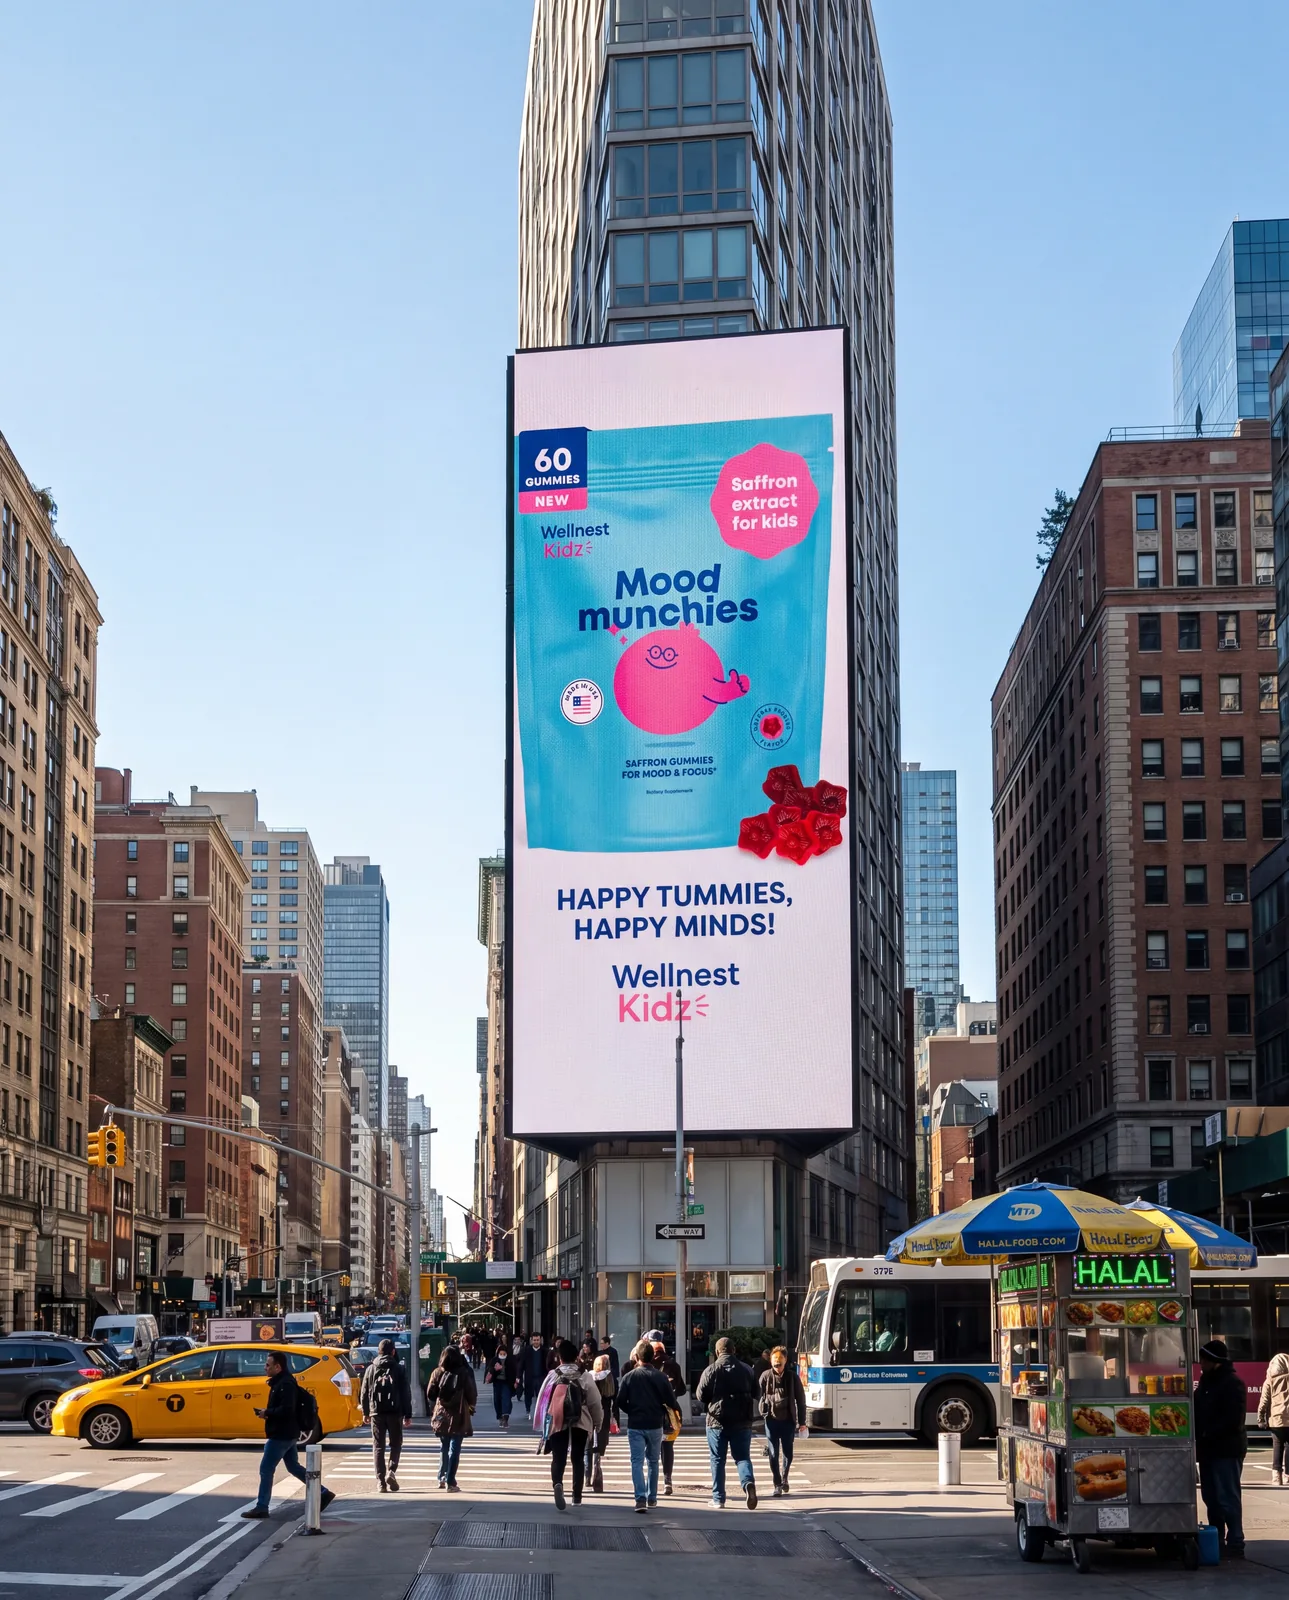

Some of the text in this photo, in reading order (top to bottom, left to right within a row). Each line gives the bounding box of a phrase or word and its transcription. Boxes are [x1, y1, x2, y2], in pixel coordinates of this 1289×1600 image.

[534, 447, 572, 472] 60
[525, 474, 580, 487] GUMMIES
[731, 474, 798, 492] Saffron
[535, 494, 569, 508] NEW
[731, 494, 798, 512] extract
[732, 512, 798, 531] for kids
[541, 522, 610, 540] Wellnest
[544, 541, 583, 558] Kidz
[615, 563, 722, 600] Mood
[578, 595, 759, 632] munchies
[625, 756, 714, 768] SAFFRON GUMMIES
[621, 770, 640, 779] FOR
[642, 769, 672, 778] MOOD
[673, 768, 680, 777] &
[557, 881, 793, 911] HAPPY TUMMIES,
[574, 912, 775, 940] HAPPY MINDS!
[611, 962, 740, 989] Wellnest
[618, 992, 692, 1023] Kidz
[1009, 1207, 1036, 1217] MTA
[1078, 1259, 1169, 1283] HALAL
